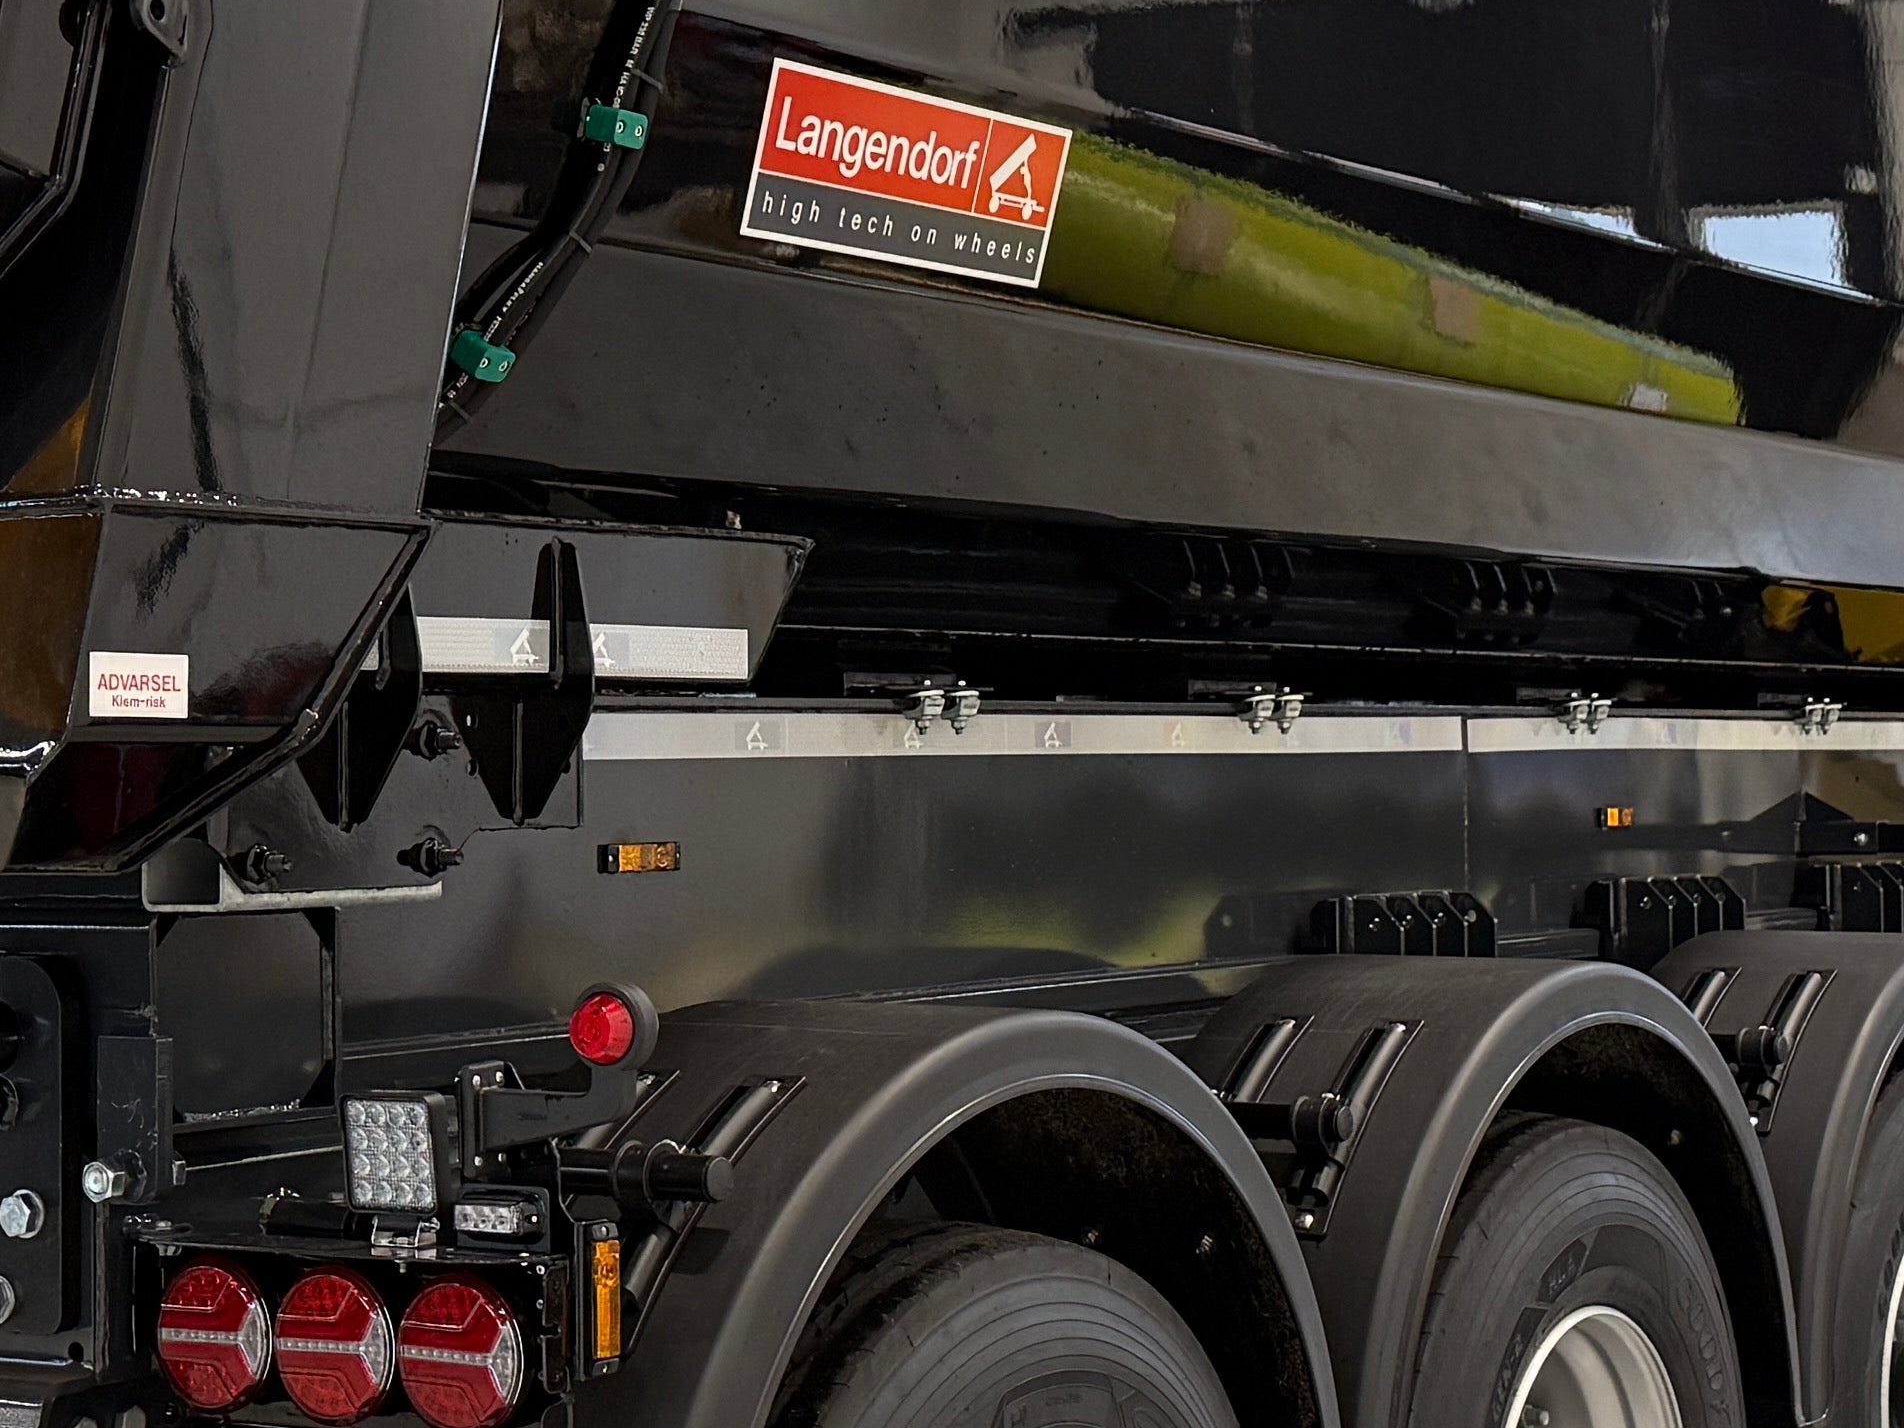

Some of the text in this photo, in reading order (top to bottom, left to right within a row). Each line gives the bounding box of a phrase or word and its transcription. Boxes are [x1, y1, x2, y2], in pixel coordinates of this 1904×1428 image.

[775, 95, 981, 190] Langendorf
[762, 190, 1037, 266] high tech on wheels
[97, 673, 181, 692] ADVARSEL
[111, 694, 166, 709] Klem-risk
